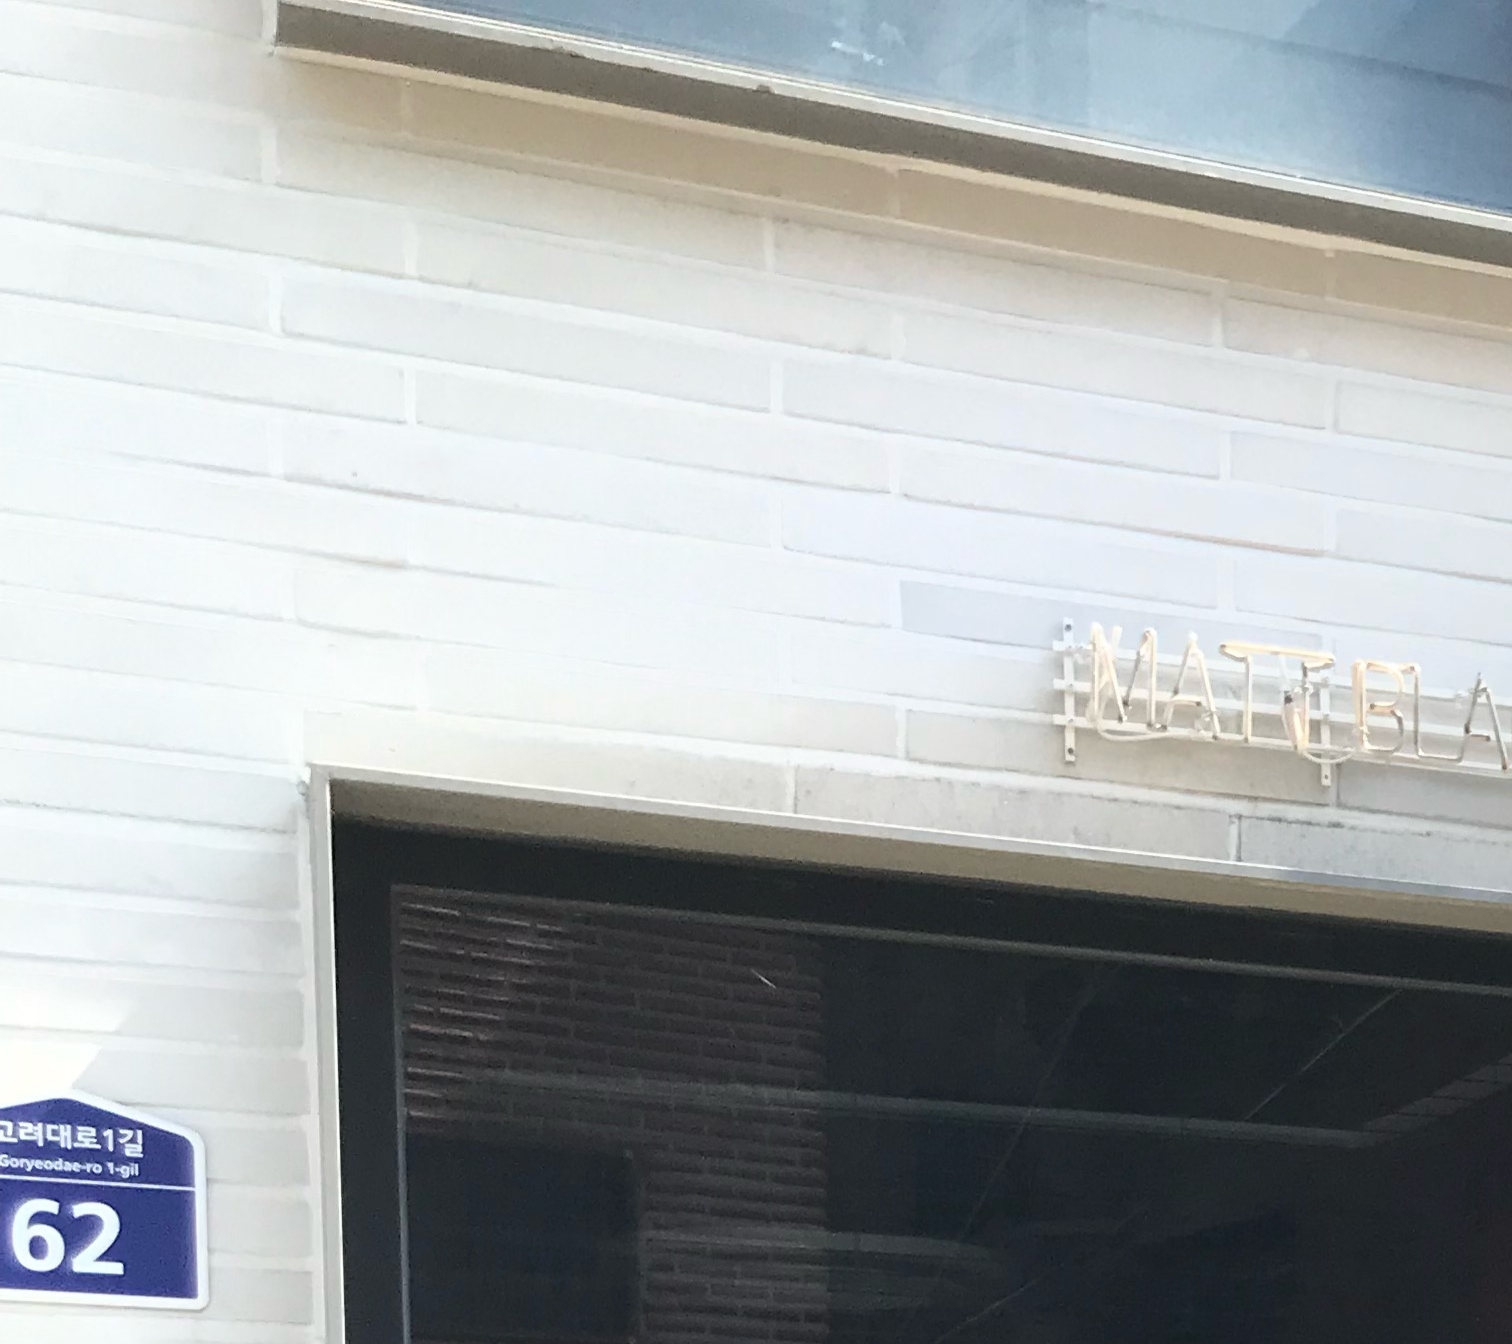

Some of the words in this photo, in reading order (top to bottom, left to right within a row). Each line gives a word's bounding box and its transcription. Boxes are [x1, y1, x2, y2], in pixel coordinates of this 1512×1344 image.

[1089, 621, 1335, 752] MATT
[0, 1119, 144, 1158] 고려대로1길
[0, 1154, 103, 1173] Goryeodae-ro
[107, 1161, 140, 1179] 1-gil
[12, 1198, 124, 1275] 62
